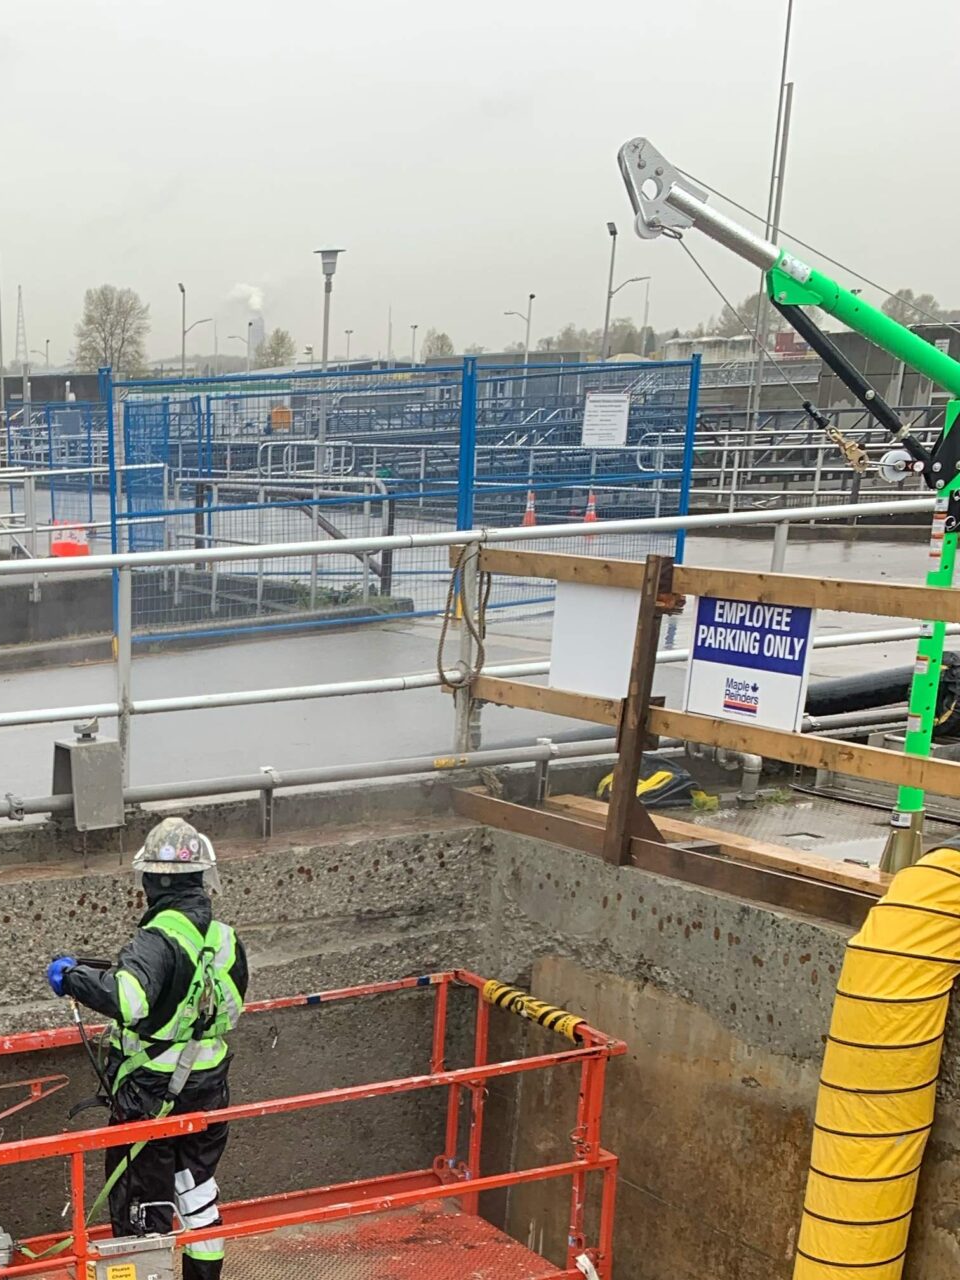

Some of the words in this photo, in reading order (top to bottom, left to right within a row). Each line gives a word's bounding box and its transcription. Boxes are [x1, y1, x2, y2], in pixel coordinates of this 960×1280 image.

[714, 600, 792, 632] EMPLOYEE
[697, 624, 760, 655] PARKING
[763, 634, 805, 661] ONLY
[725, 677, 750, 692] Maple
[724, 689, 759, 705] Reinders
